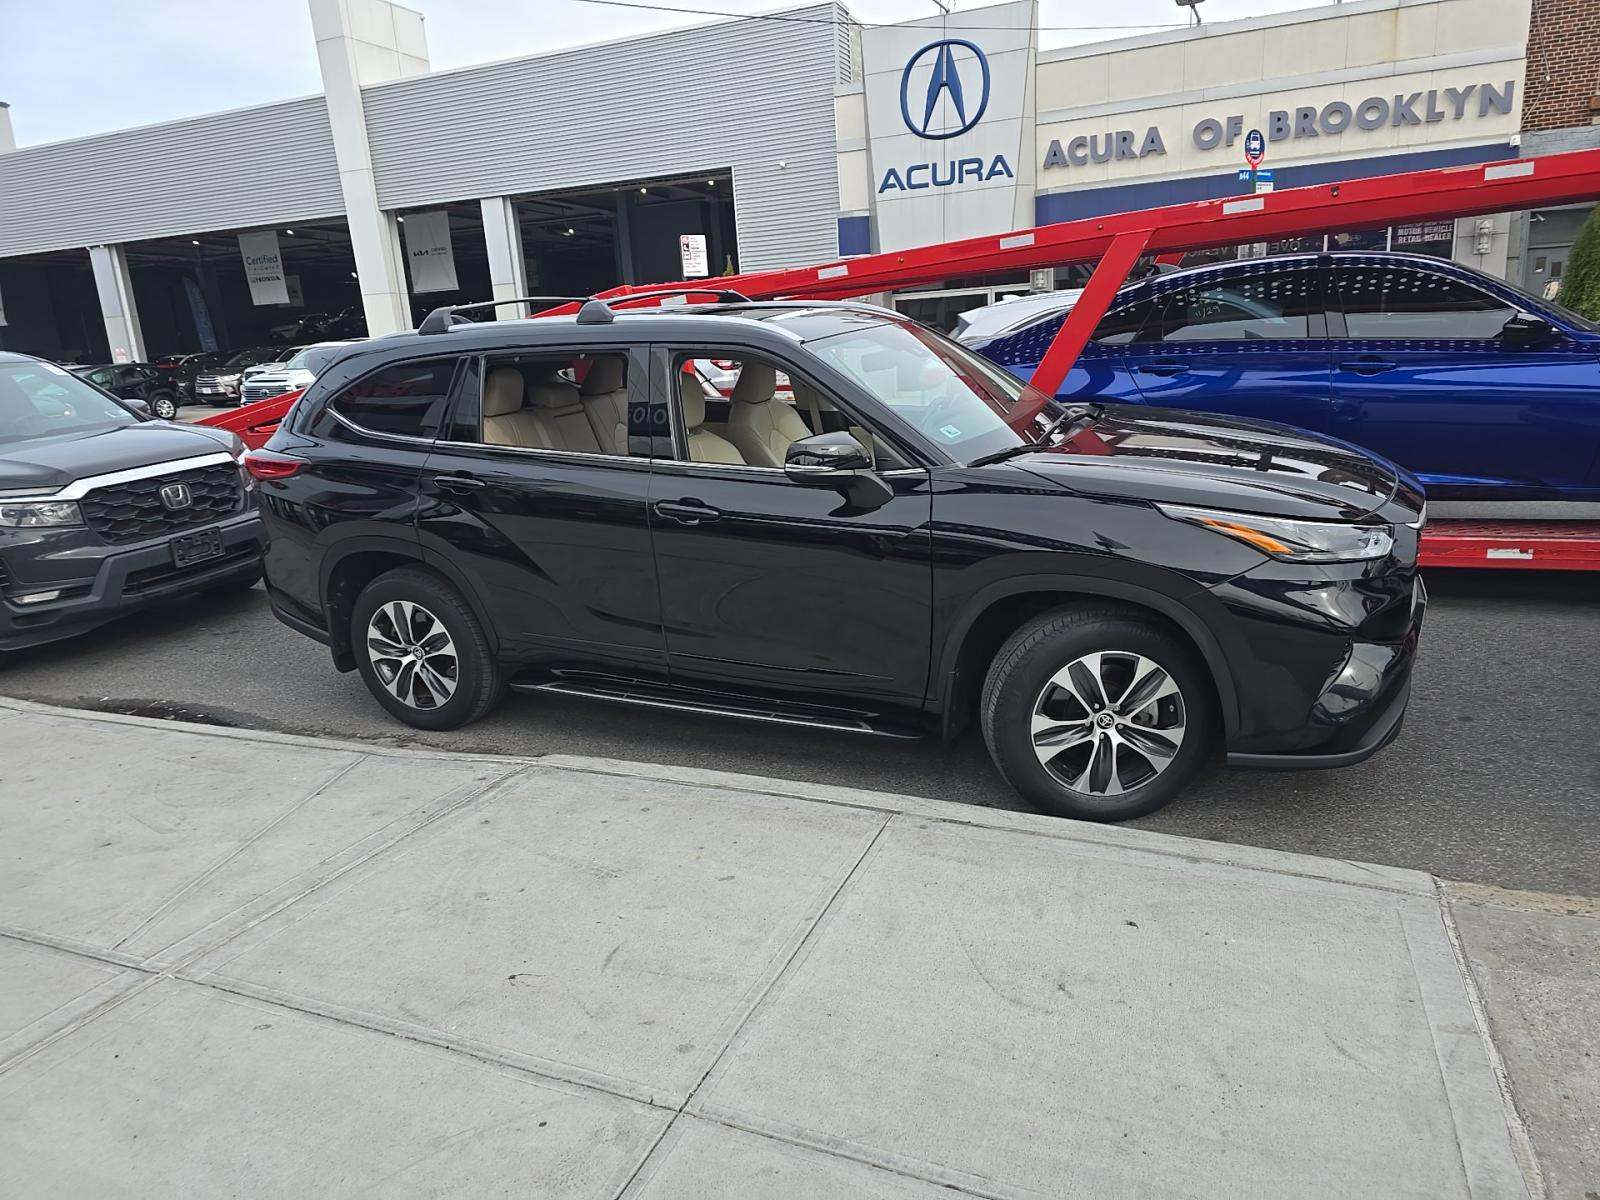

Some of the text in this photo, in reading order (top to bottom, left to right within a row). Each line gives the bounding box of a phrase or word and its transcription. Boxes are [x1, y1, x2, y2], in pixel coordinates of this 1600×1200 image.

[1043, 80, 1515, 169] ACURA OF BROOKLYN
[878, 154, 1014, 193] ACURA
[1424, 232, 1452, 241] DEALER
[246, 254, 279, 266] Certified
